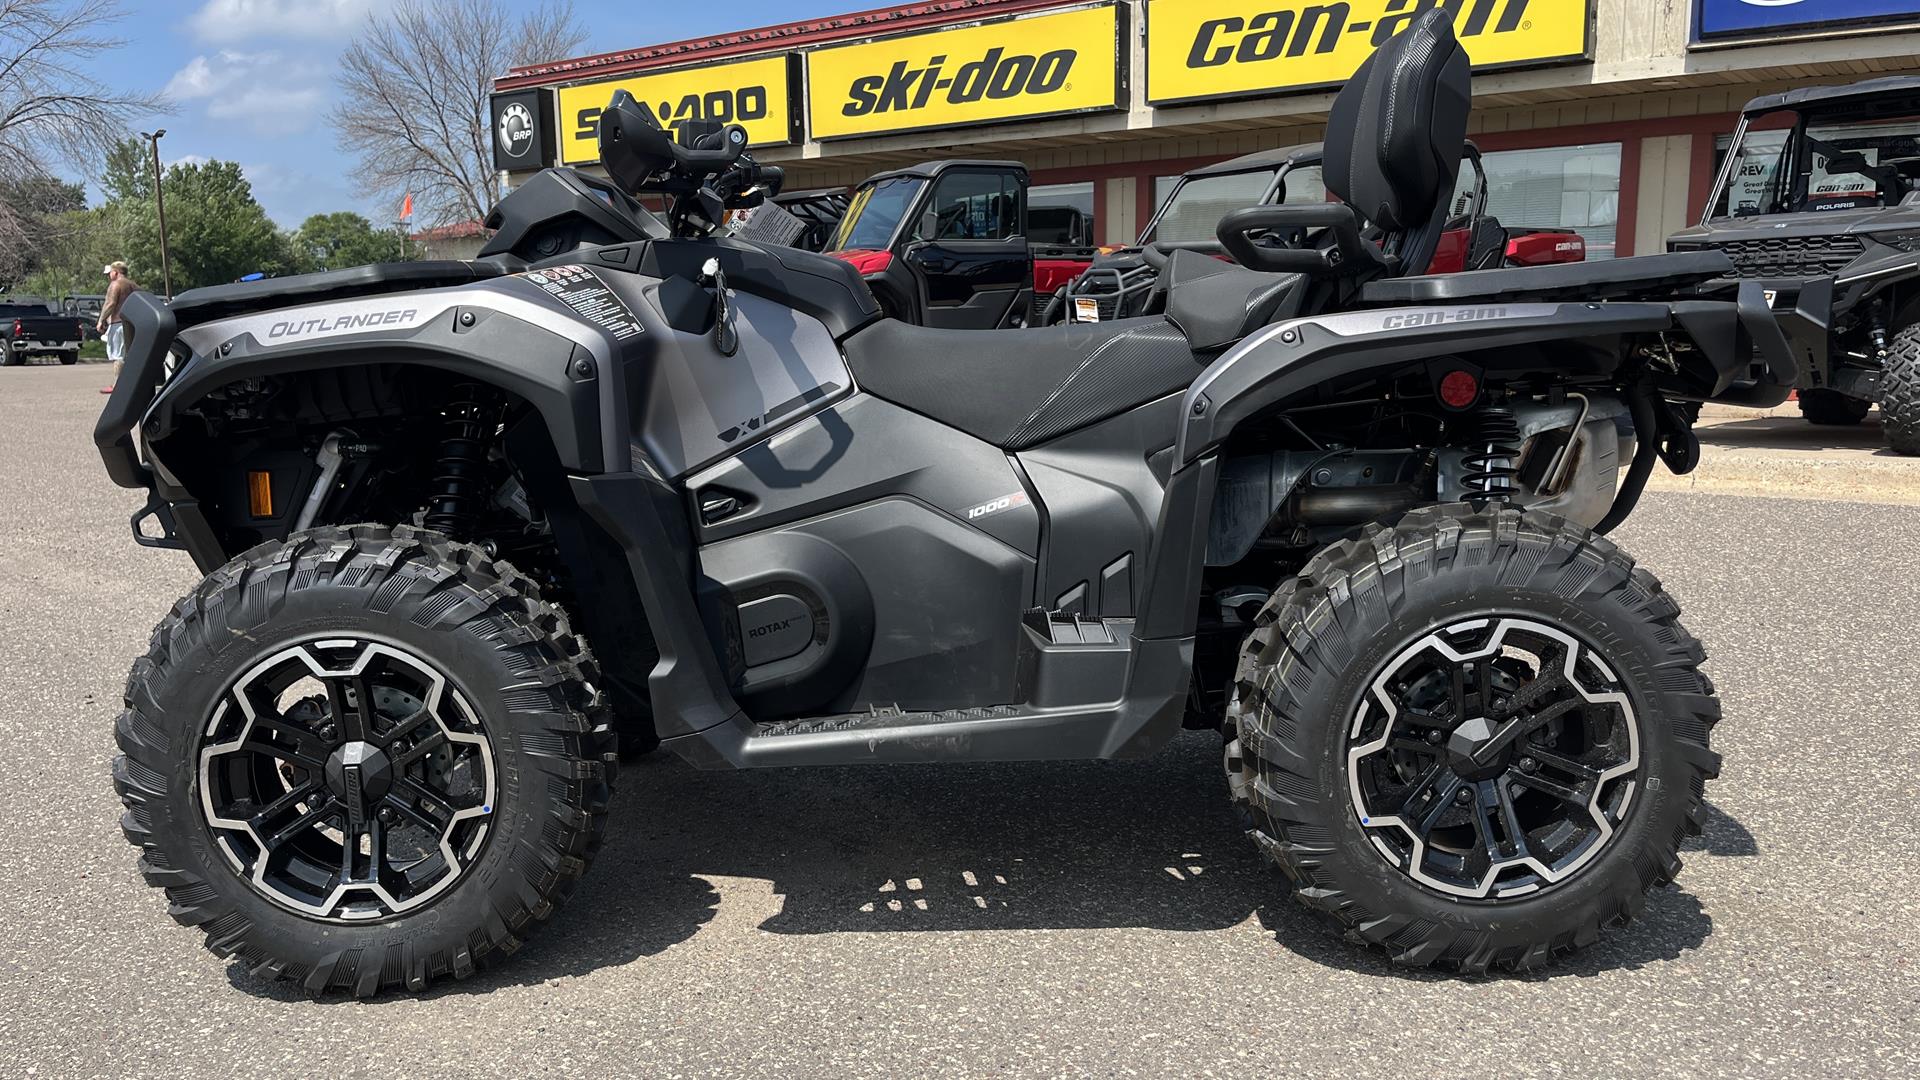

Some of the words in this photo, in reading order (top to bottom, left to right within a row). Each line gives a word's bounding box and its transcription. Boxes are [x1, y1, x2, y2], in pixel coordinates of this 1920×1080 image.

[842, 47, 1077, 117] ski-doo
[513, 130, 531, 140] BRP
[1817, 183, 1864, 192] can-am
[1816, 202, 1855, 210] POLARIS
[269, 309, 417, 338] OUTLANDER
[1382, 307, 1506, 330] can-am
[749, 620, 791, 638] ROTAX
